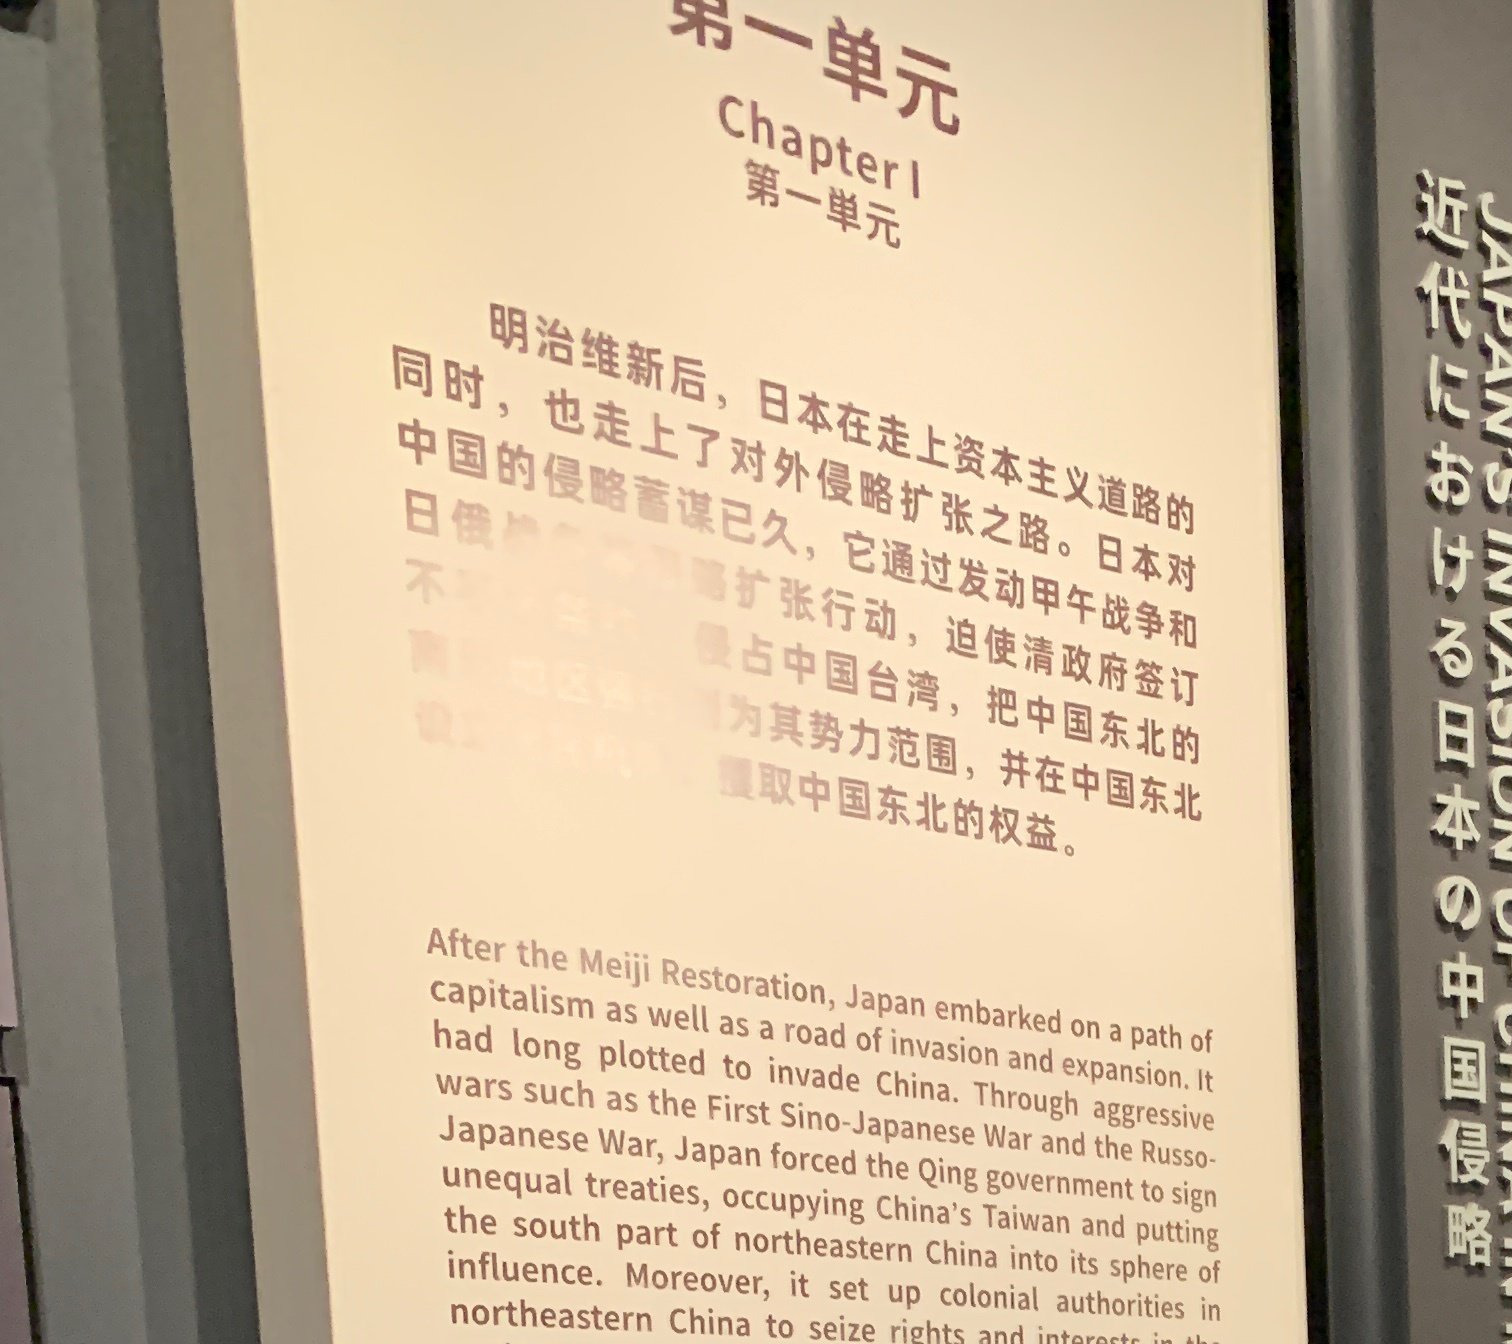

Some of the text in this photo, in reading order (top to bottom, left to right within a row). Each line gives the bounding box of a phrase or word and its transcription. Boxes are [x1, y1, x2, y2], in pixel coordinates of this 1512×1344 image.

[667, 0, 961, 136] 第一单元
[717, 94, 899, 190] Chapter
[1417, 168, 1492, 1268] 近代における日本の中国侵略
[426, 927, 1214, 1054] After the Meiji Restoration, Japan embarked on a path of
[429, 977, 1214, 1094] capitalism as well as a road of invasion and expansion. It
[433, 1017, 1215, 1132] had long plotted to invade China. Through aggressive
[441, 1165, 1220, 1254] unequal treaties, occupying China's Taiwan and putting
[443, 1203, 1222, 1285] the south part of northeastern China into its sphere of
[447, 1249, 1222, 1322] influence. Moreover, it set up colonial authorities in
